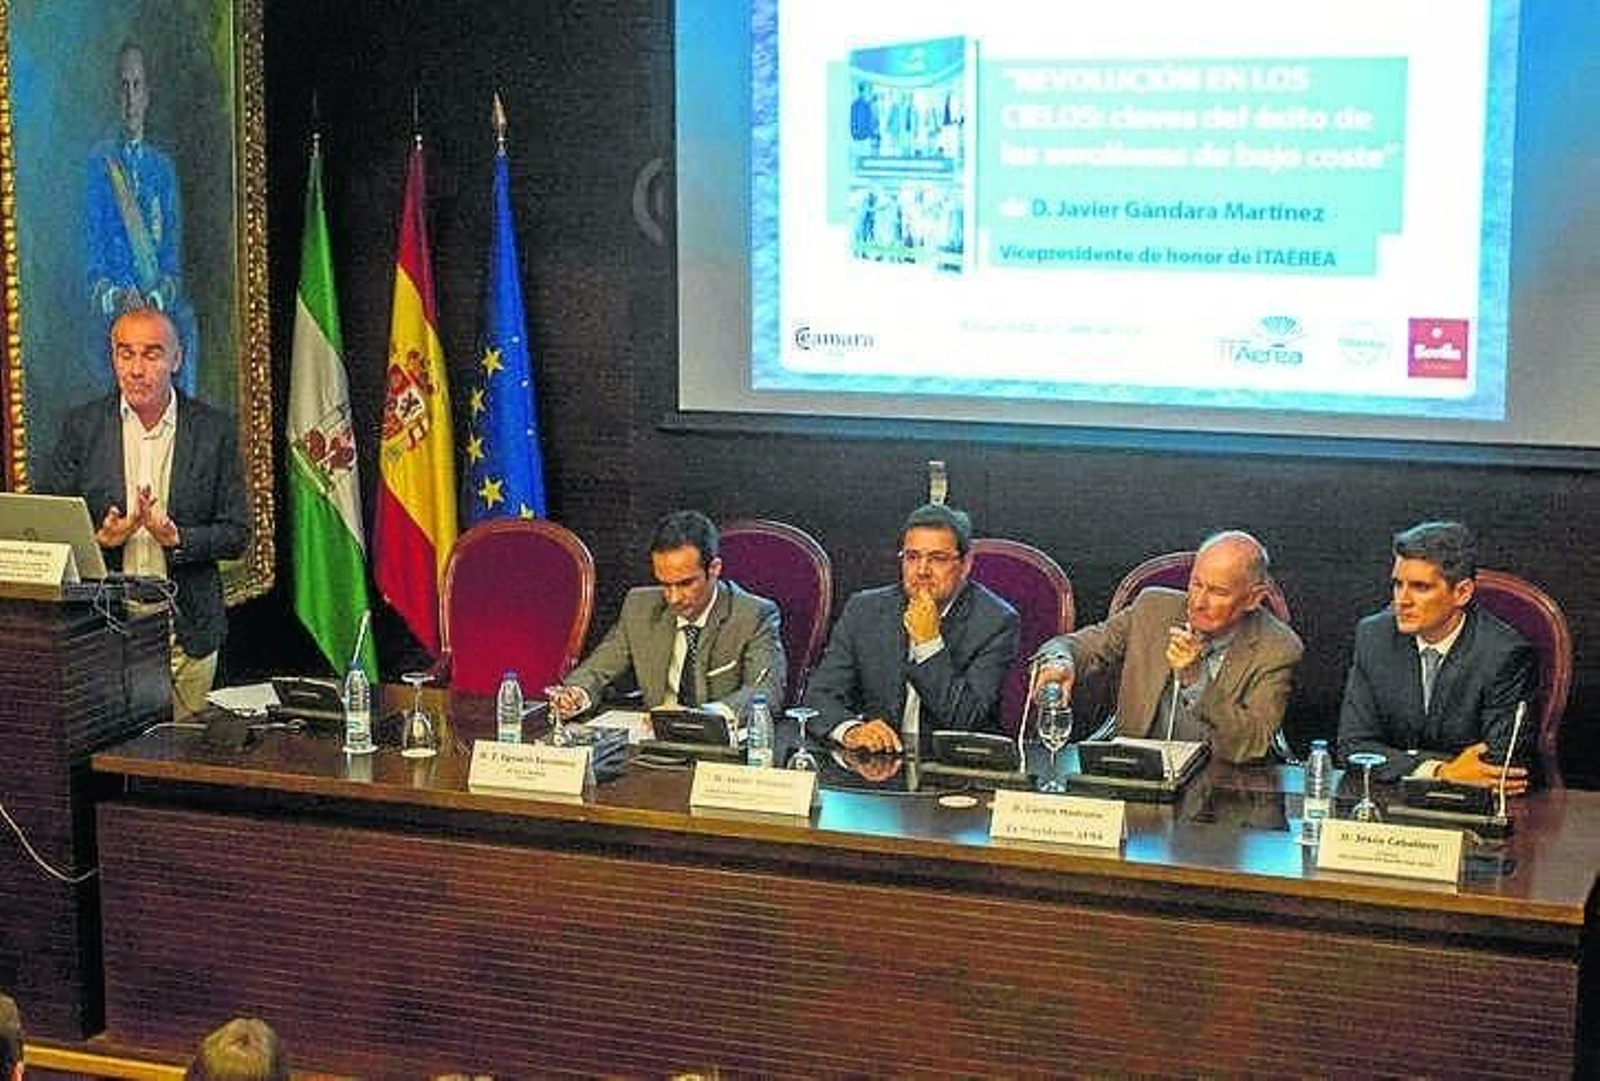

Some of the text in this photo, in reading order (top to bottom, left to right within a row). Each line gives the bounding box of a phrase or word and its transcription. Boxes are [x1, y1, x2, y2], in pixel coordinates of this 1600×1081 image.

[1250, 66, 1312, 91] LOS
[1031, 199, 1052, 218] D.
[1056, 200, 1119, 219] Javier
[1000, 245, 1134, 264] Vicepresidente
[1138, 247, 1162, 264] de
[1167, 248, 1223, 265] honor
[1228, 248, 1251, 265] de
